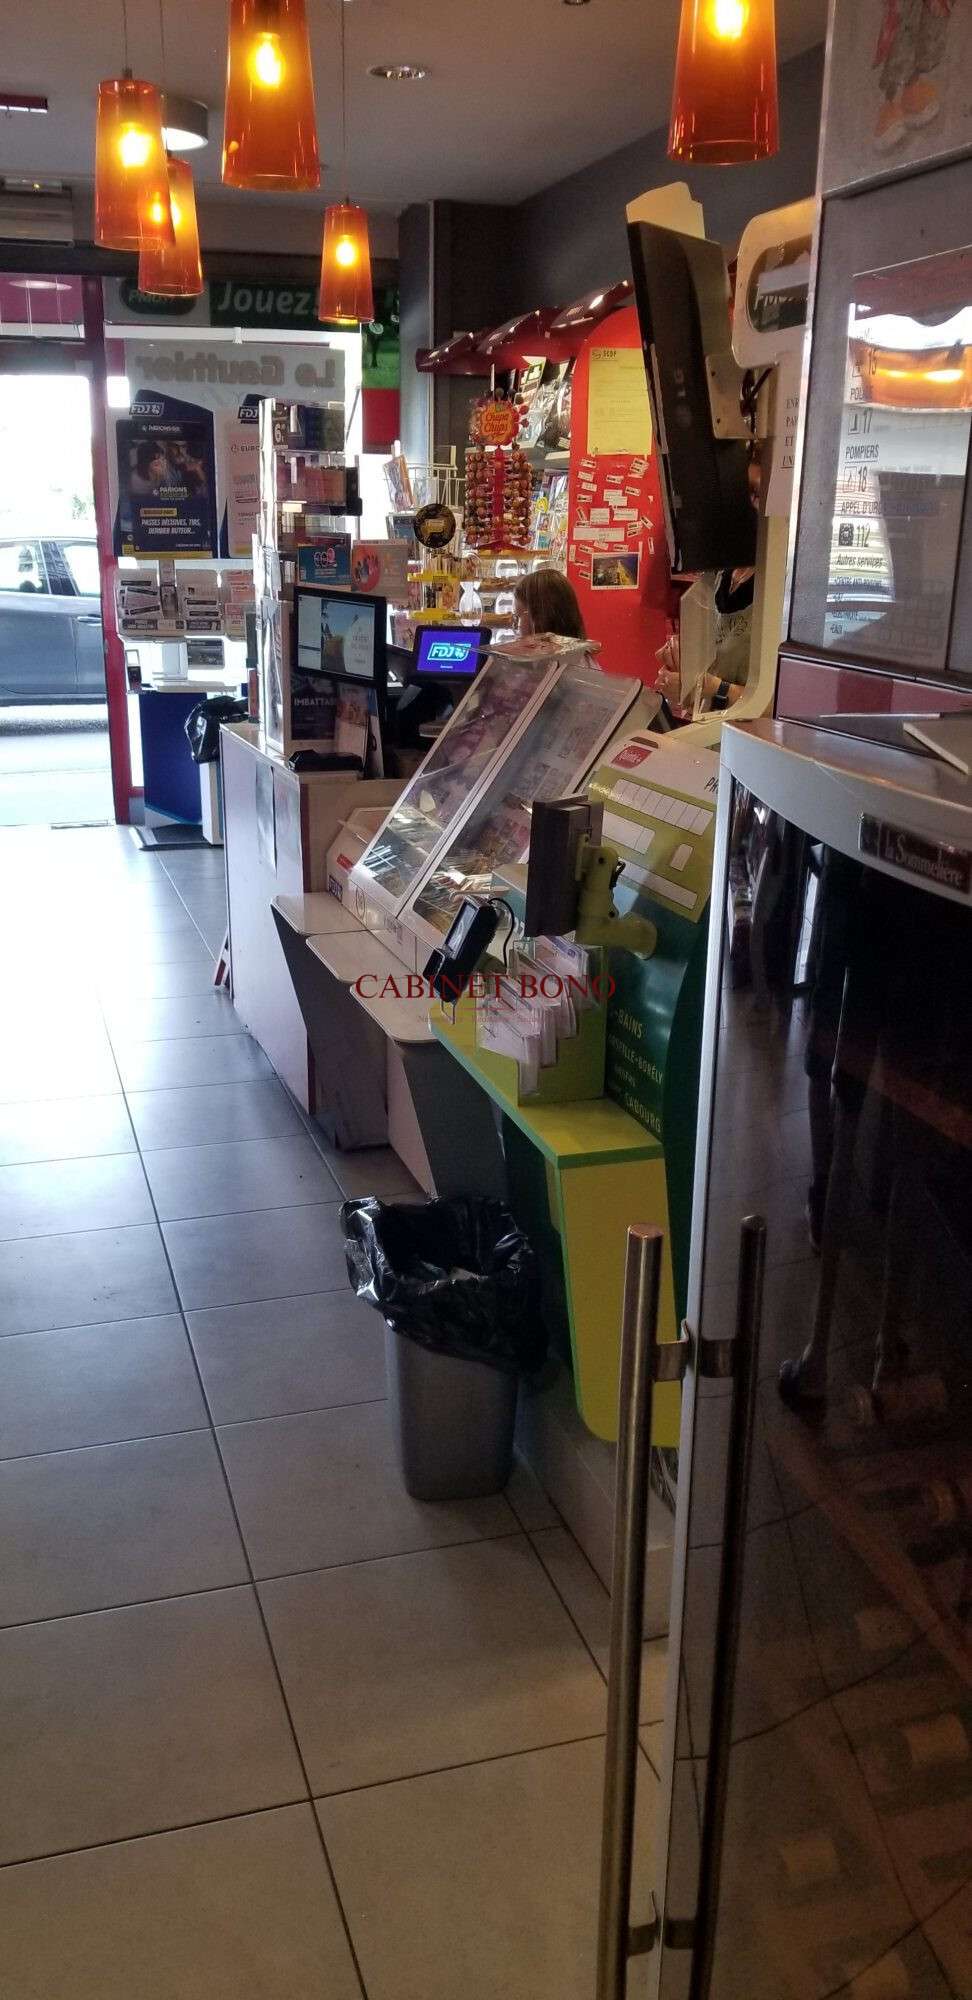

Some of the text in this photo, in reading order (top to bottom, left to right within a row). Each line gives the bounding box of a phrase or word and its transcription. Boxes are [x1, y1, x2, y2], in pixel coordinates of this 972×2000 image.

[217, 278, 310, 316] Jouez
[131, 404, 150, 414] FDJ
[239, 409, 259, 419] FDJ
[845, 445, 880, 460] POMPIERS
[858, 467, 868, 492] 18
[841, 501, 860, 514] APPEL
[857, 525, 871, 548] 112
[836, 553, 857, 567] Autres
[432, 646, 453, 658] FDJ
